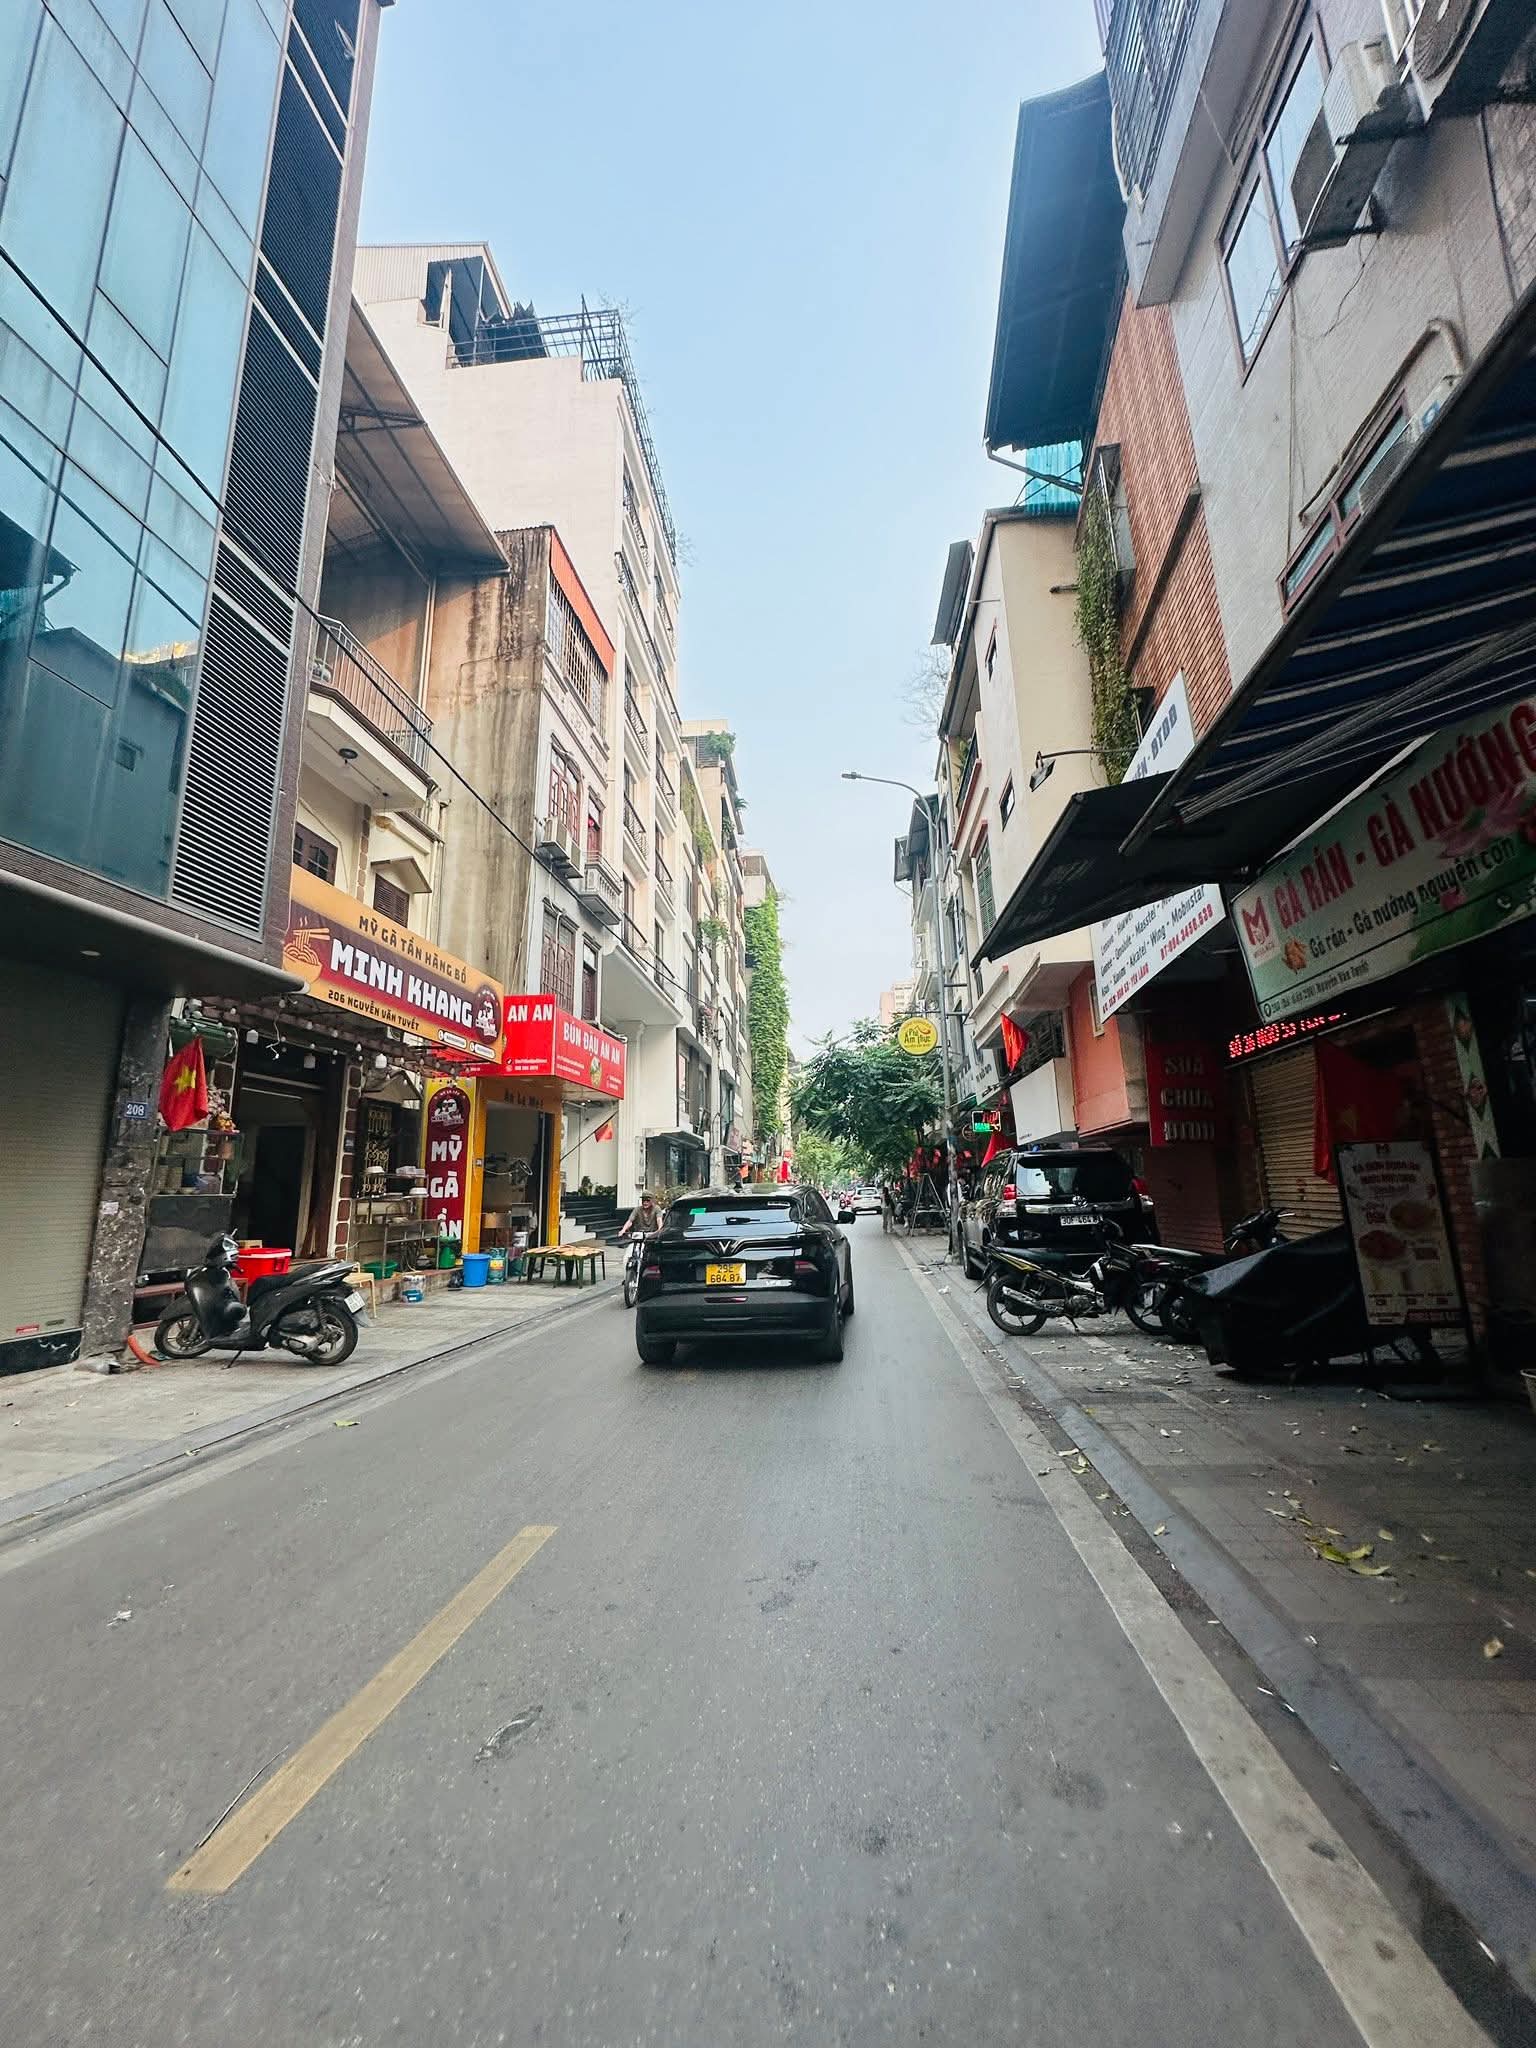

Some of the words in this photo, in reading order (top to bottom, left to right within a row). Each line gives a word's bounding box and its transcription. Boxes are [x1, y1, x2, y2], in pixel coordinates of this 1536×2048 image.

[1275, 871, 1306, 929] GÀ
[1301, 843, 1353, 911] RÁN
[1368, 792, 1415, 868] GÀ
[1310, 936, 1326, 958] Gà
[1325, 928, 1347, 951] rán
[1353, 911, 1374, 934] Gà
[1373, 891, 1418, 927] nướng
[1418, 857, 1480, 905] nguyên
[381, 929, 397, 948] GÀ
[425, 952, 452, 978] HÀNG
[330, 938, 404, 998] MINH
[407, 974, 474, 1029] KHANG
[328, 989, 345, 1003] 206
[347, 996, 380, 1016] NGUYỄN
[381, 1008, 397, 1022] VĂN
[397, 1015, 420, 1031] TUYẾT
[507, 1005, 528, 1022] AN
[532, 1004, 553, 1021] AN
[563, 1020, 582, 1048] BÚN
[583, 1031, 599, 1057] ĐẬU
[600, 1041, 610, 1061] AN
[611, 1047, 621, 1065] AN
[126, 1103, 145, 1116] 208
[431, 1134, 463, 1163] MỲ
[429, 1170, 459, 1199] GÀ
[436, 1207, 463, 1241] ẦN
[710, 1273, 740, 1283] 684.87
